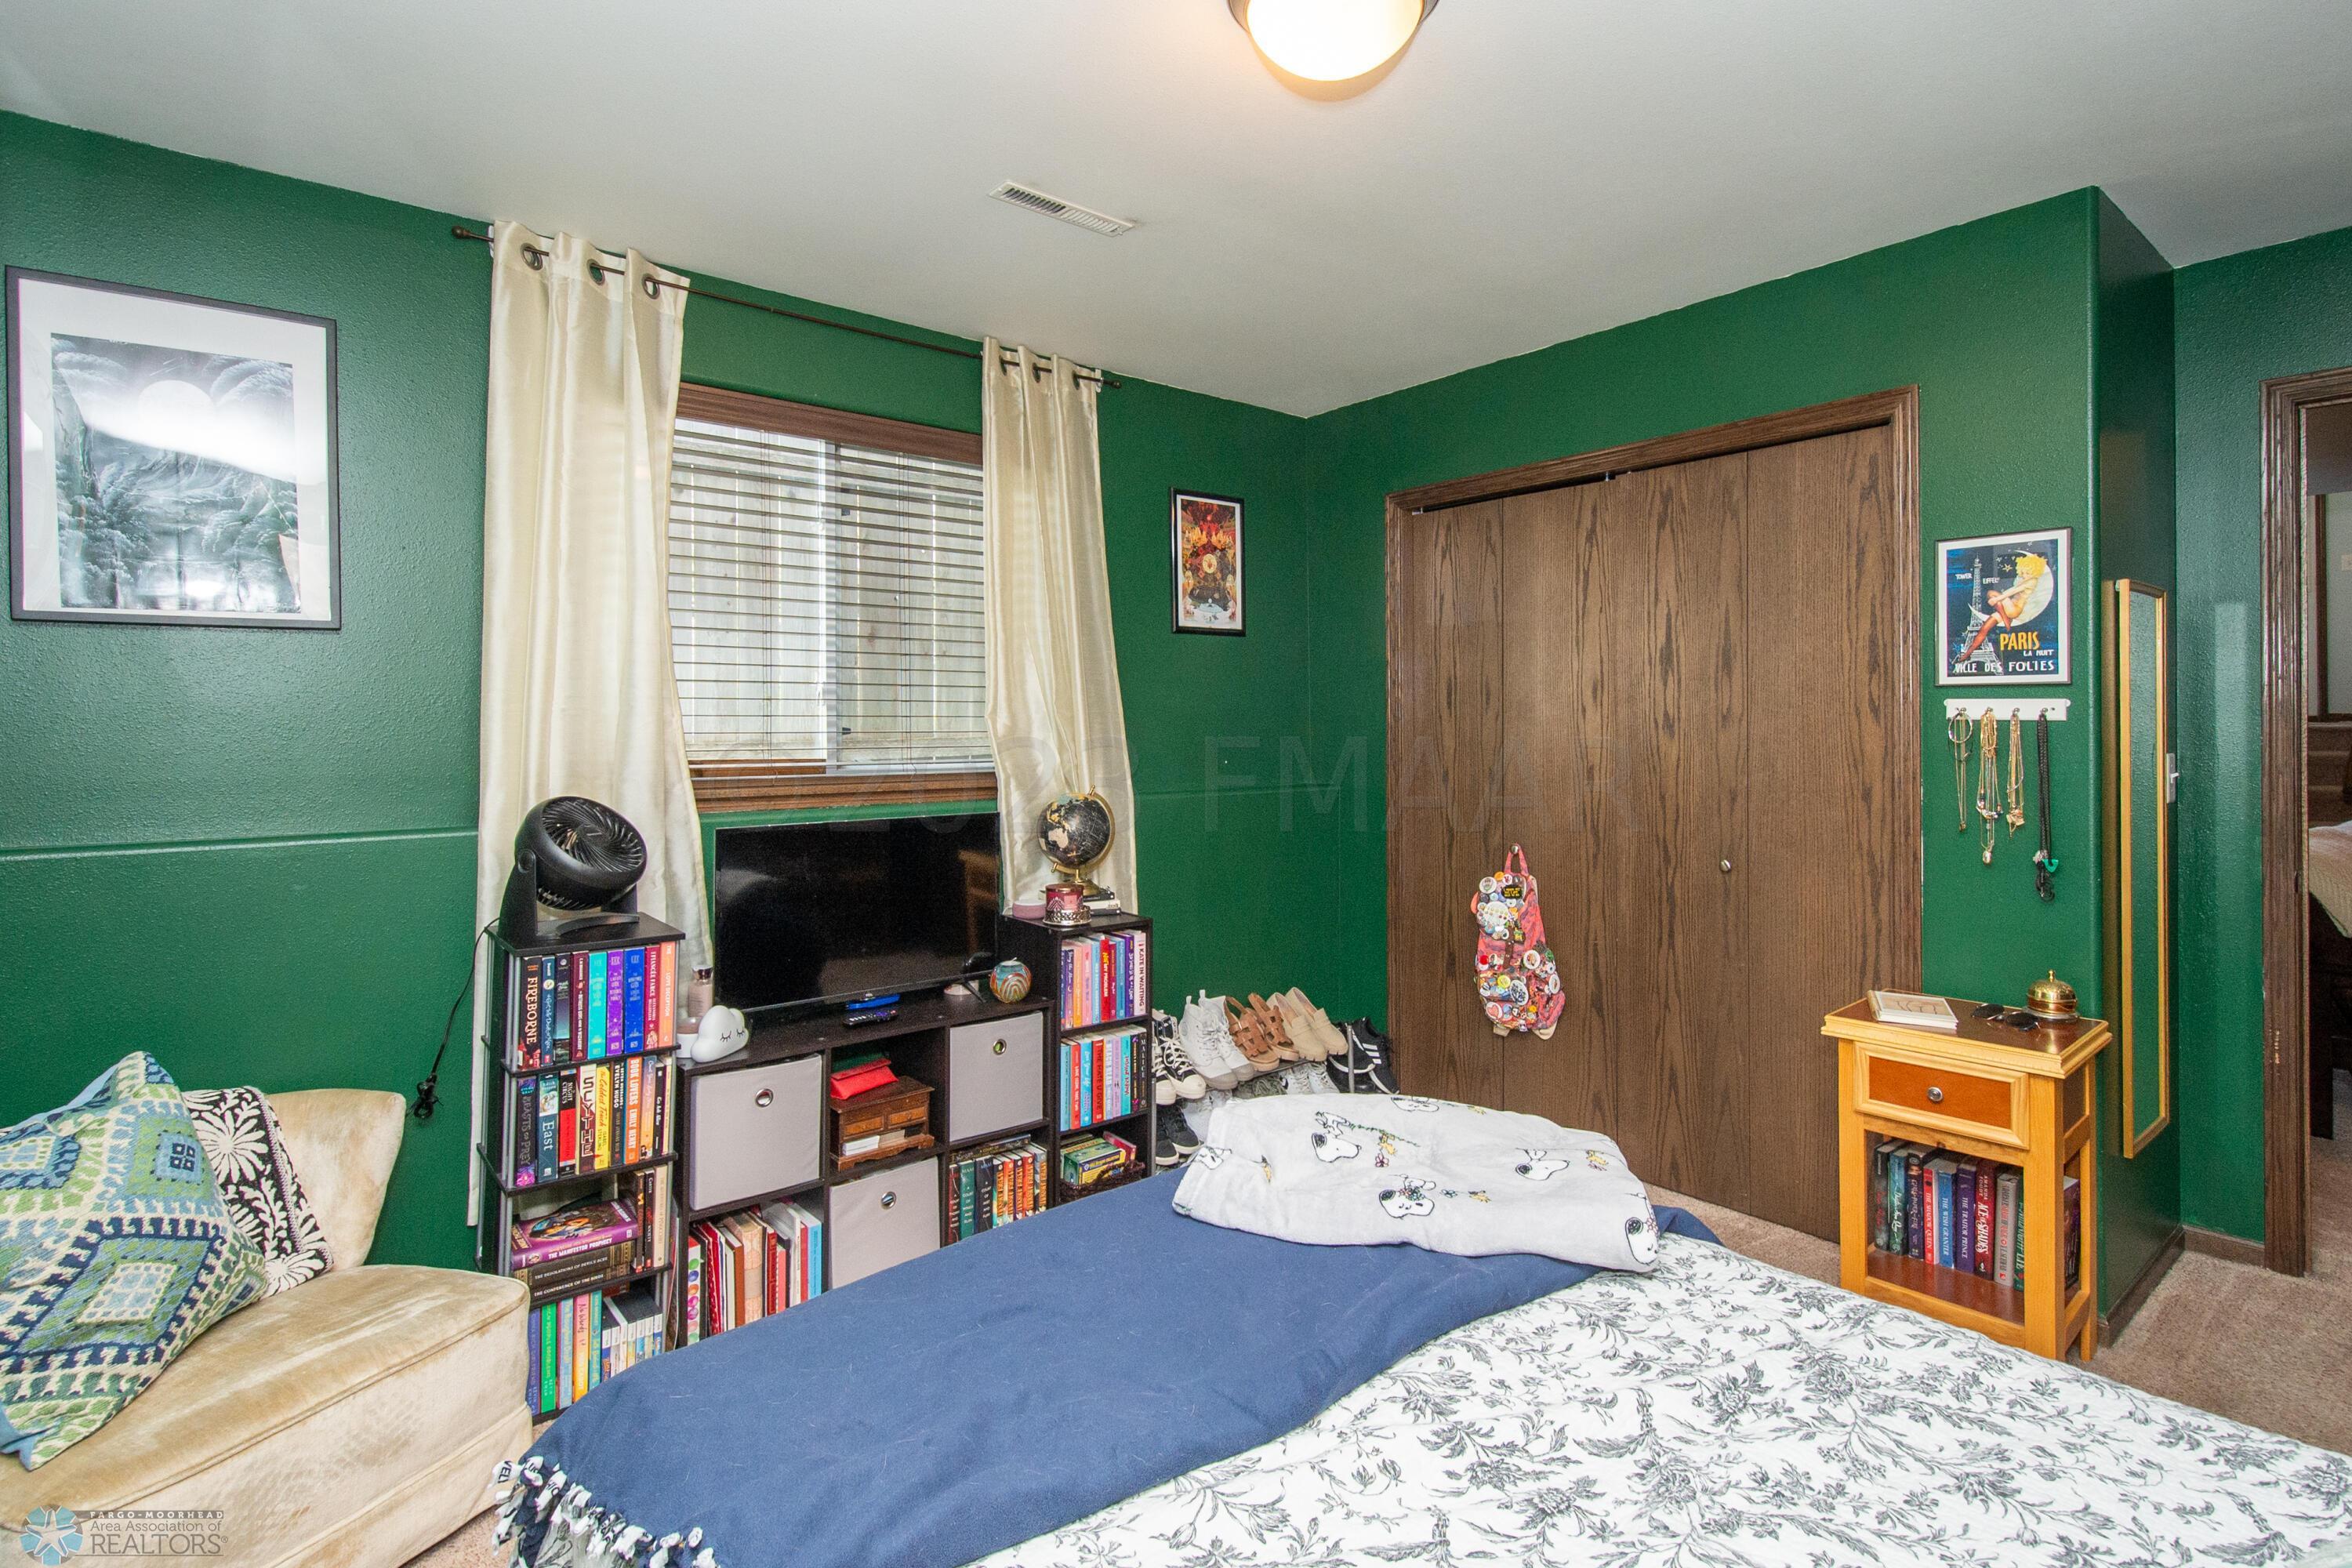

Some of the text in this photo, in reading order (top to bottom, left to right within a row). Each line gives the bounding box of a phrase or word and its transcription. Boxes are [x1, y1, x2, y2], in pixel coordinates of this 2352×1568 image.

[1999, 632, 2041, 651] PARIS
[1984, 662, 2002, 672] DES
[1103, 963, 1109, 972] MY
[1139, 967, 1145, 976] IN
[524, 976, 539, 1044] FIREBORNE
[599, 1078, 608, 1104] Coldest
[657, 1096, 662, 1105] Go
[521, 1096, 532, 1132] BEASTS
[627, 1059, 640, 1149] BOOK LOVERS EMILY HENRY
[598, 1105, 608, 1127] Touch
[543, 1120, 555, 1151] East
[519, 1141, 531, 1165] PREY
[1976, 1201, 1989, 1254] ACE SHADES
[558, 1243, 589, 1258] MANIFESTOR
[589, 1237, 612, 1250] PROPHECY
[2016, 1252, 2025, 1270] LIE
[544, 1266, 574, 1278] DESOLATIONS
[543, 1282, 573, 1294] CONFERENCE
